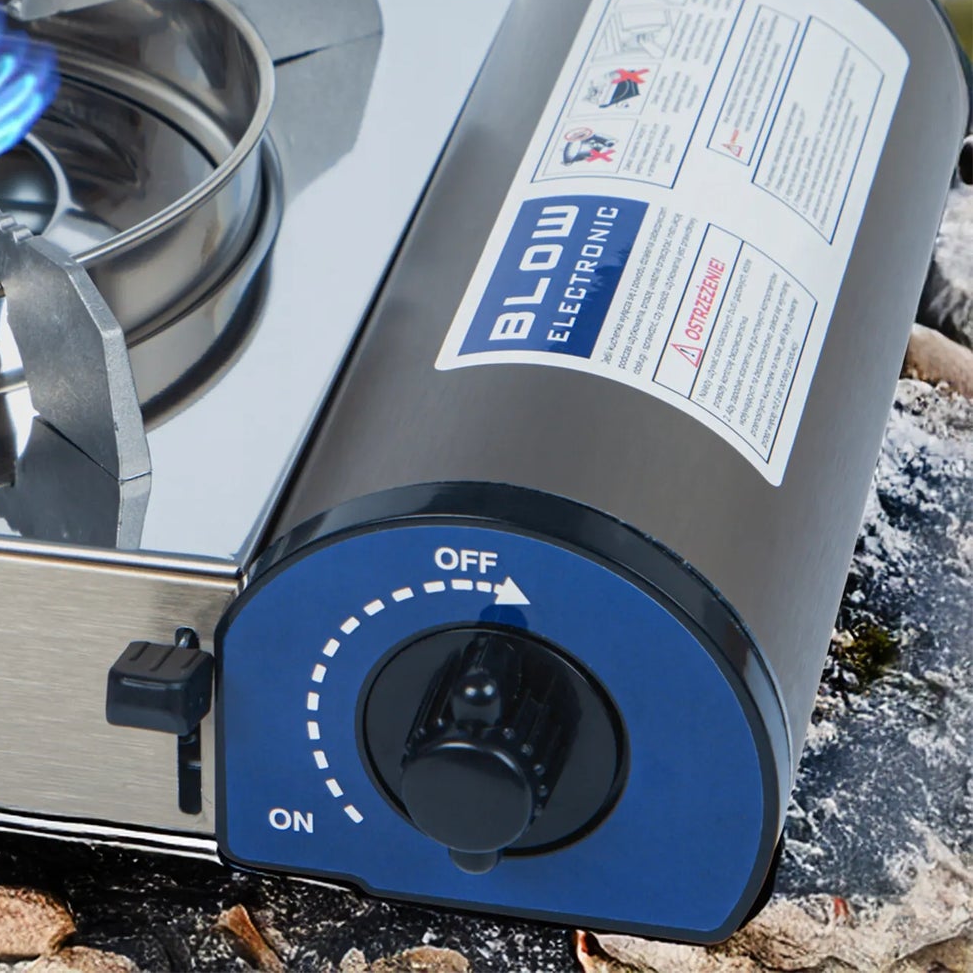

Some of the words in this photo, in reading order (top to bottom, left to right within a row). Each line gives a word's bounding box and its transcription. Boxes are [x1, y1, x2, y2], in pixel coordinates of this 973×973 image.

[489, 205, 579, 341] BLOW
[547, 206, 619, 343] ELECTRONIC
[684, 257, 727, 341] OSTRZEŻENIE!
[434, 547, 498, 573] OFF
[269, 808, 313, 833] ON
